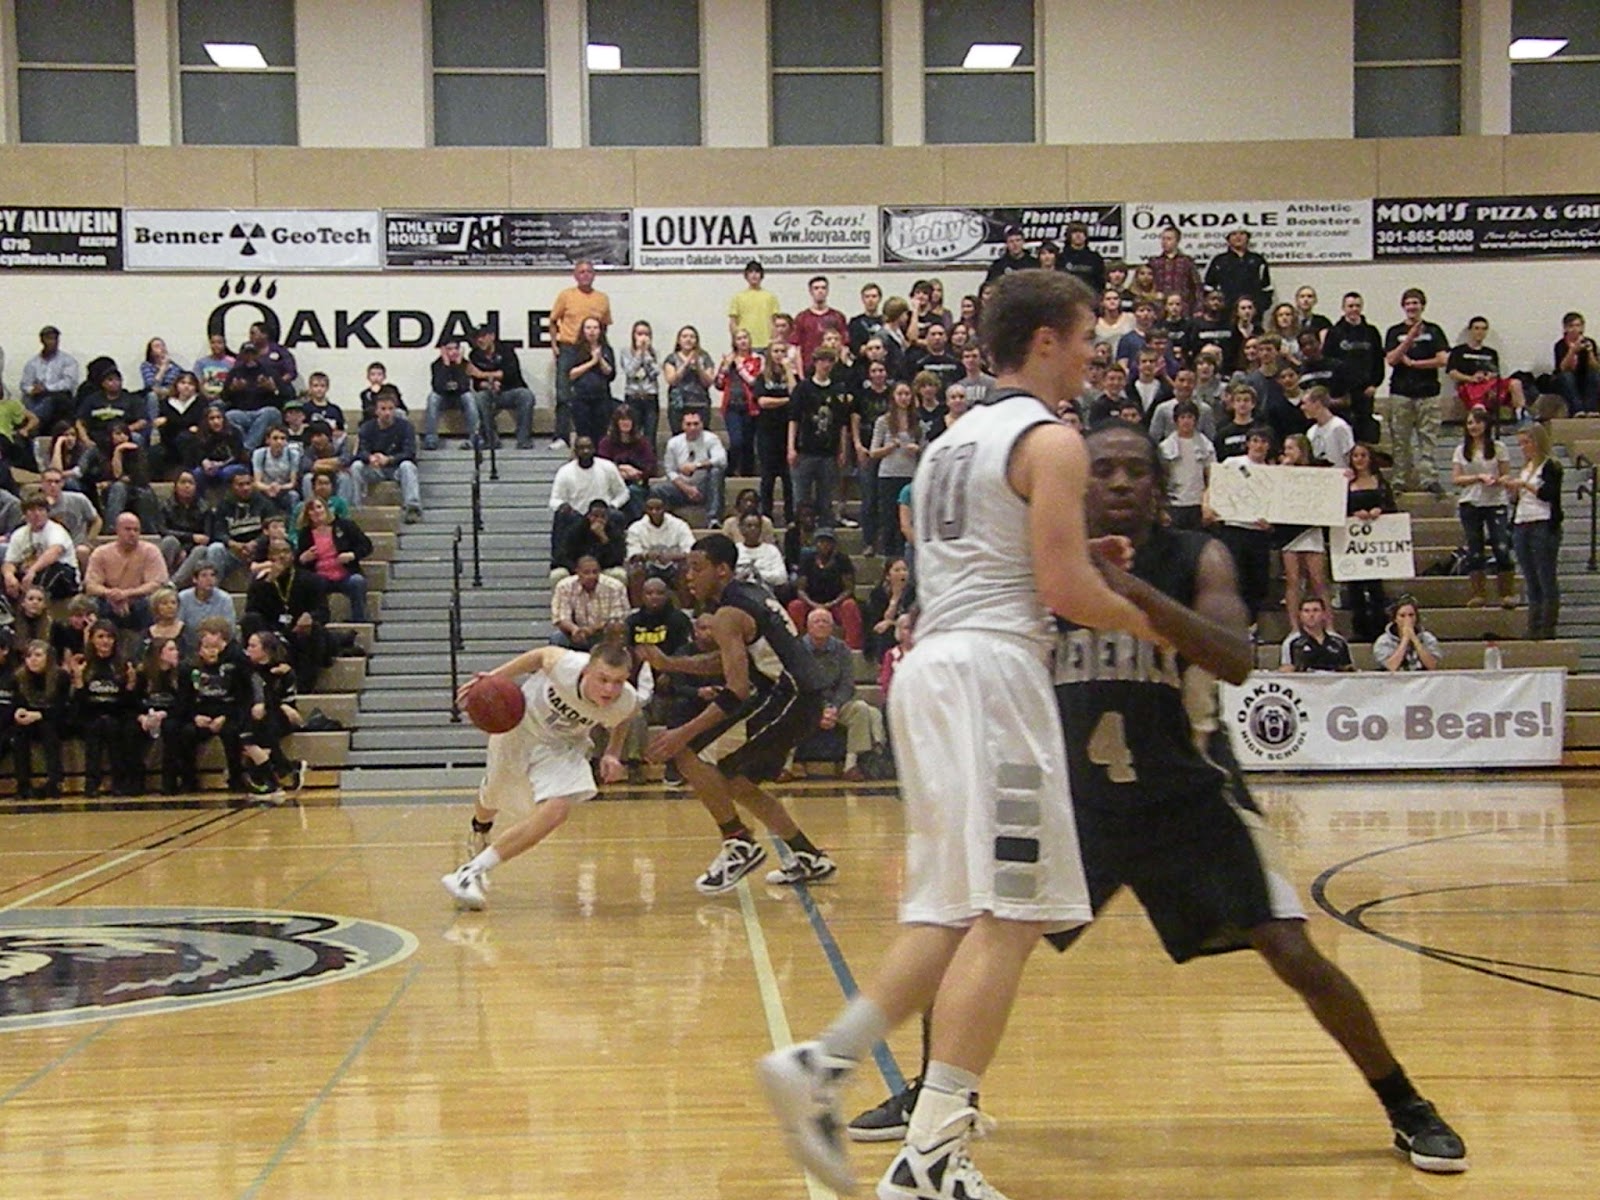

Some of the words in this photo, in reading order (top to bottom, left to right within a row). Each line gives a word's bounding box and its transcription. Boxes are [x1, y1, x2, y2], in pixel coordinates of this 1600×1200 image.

[1287, 203, 1352, 213] Athletic
[1376, 202, 1469, 223] MOM'S
[1476, 205, 1538, 221] PIZZA
[1543, 205, 1558, 220] &
[21, 210, 117, 233] ALLWEIN
[387, 220, 459, 234] ATHLETIC
[773, 210, 800, 231] Go
[806, 209, 866, 227] Bears!
[1132, 210, 1278, 230] OAKDALE
[1287, 216, 1361, 226] Boosters
[134, 226, 224, 245] Benner
[271, 225, 372, 245] GeoTech
[388, 233, 439, 246] HOUSE
[641, 215, 758, 246] LOUYAA
[769, 227, 871, 244] www.louyaa.org
[686, 253, 722, 266] Oakdale
[786, 252, 820, 265] Athletic
[821, 251, 872, 264] Association
[207, 299, 557, 355] OAKDALE
[1349, 523, 1372, 537] GO
[1237, 682, 1309, 724] OAKDALE
[1326, 705, 1389, 742] Go
[1404, 701, 1554, 742] Bears!
[1086, 711, 1138, 783] 4
[1241, 730, 1264, 758] HIGH
[1267, 730, 1309, 760] SCHOOL
